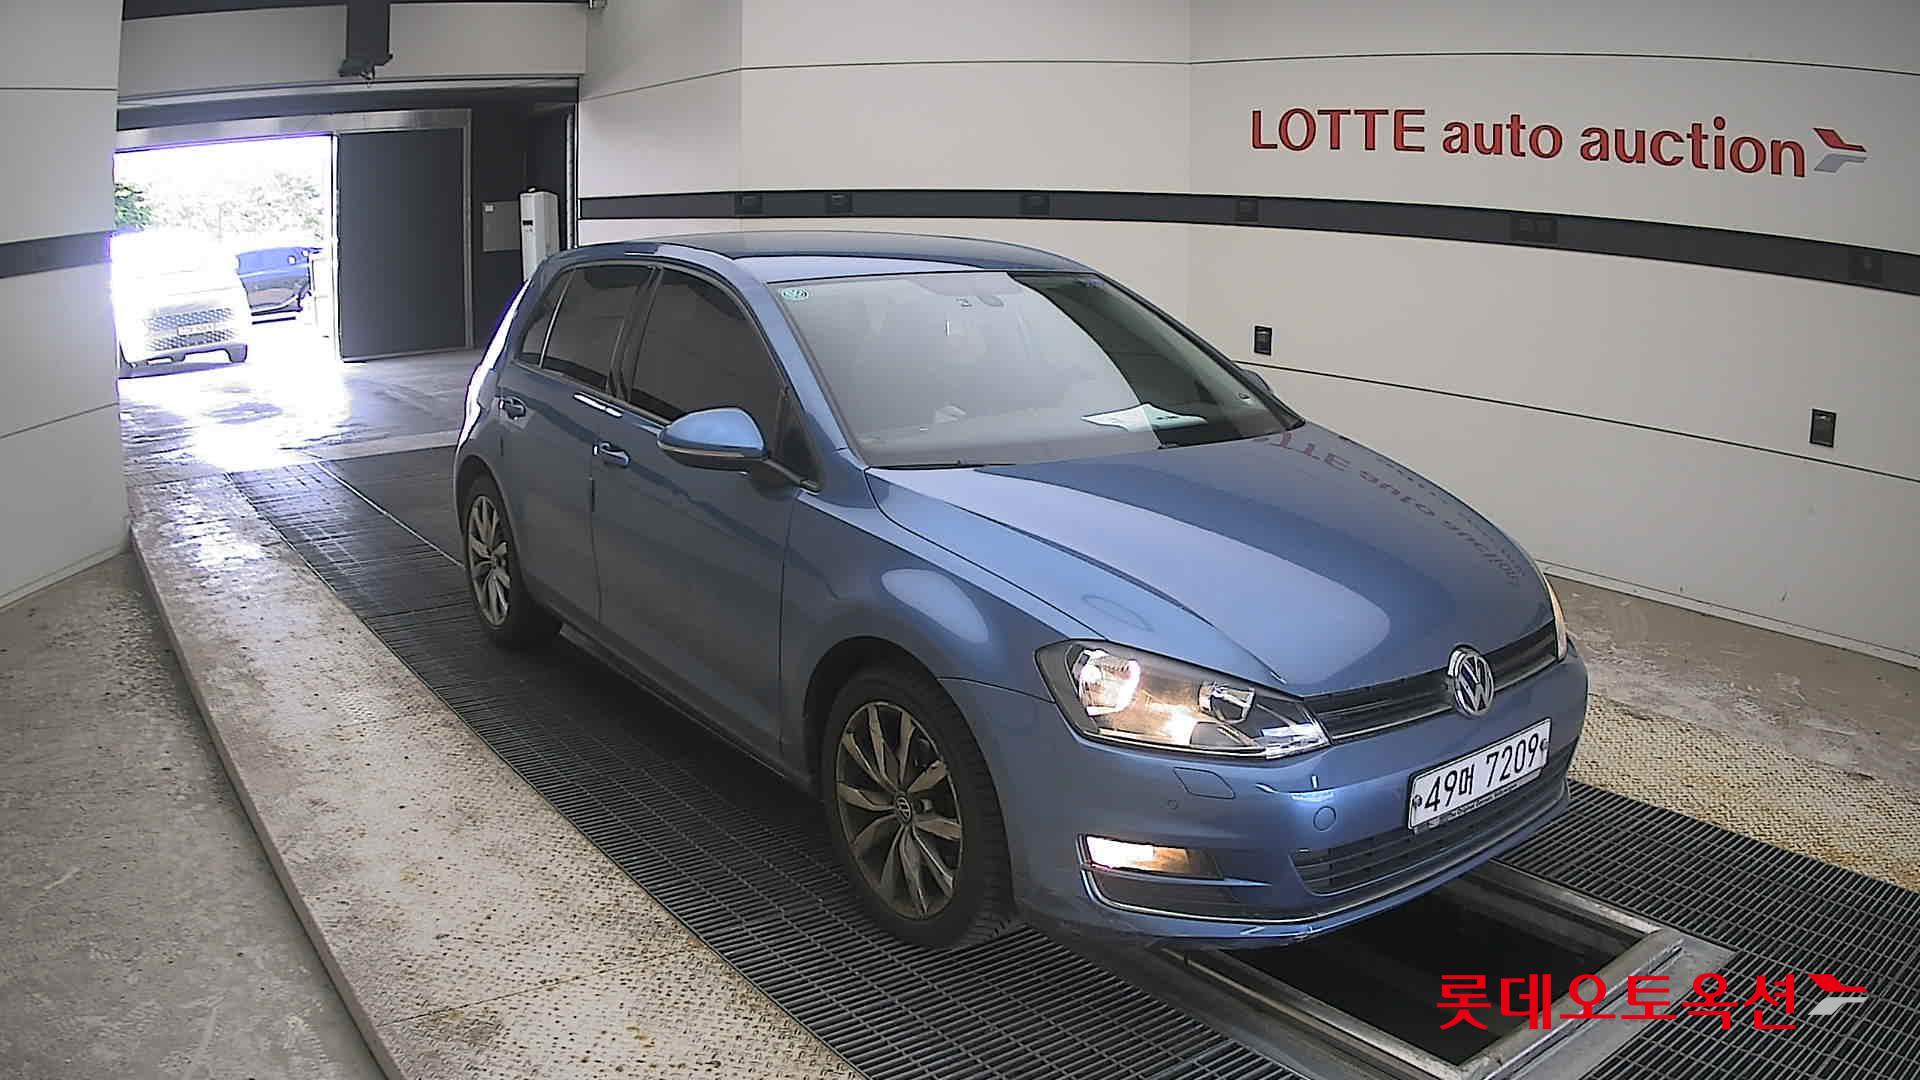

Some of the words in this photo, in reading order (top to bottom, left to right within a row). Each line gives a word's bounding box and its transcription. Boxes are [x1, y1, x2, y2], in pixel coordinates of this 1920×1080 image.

[1252, 109, 1426, 151] LOTTE
[1442, 113, 1563, 159] auto
[1579, 116, 1806, 178] auction
[1424, 763, 1475, 812] 49머
[1486, 733, 1539, 788] 7209
